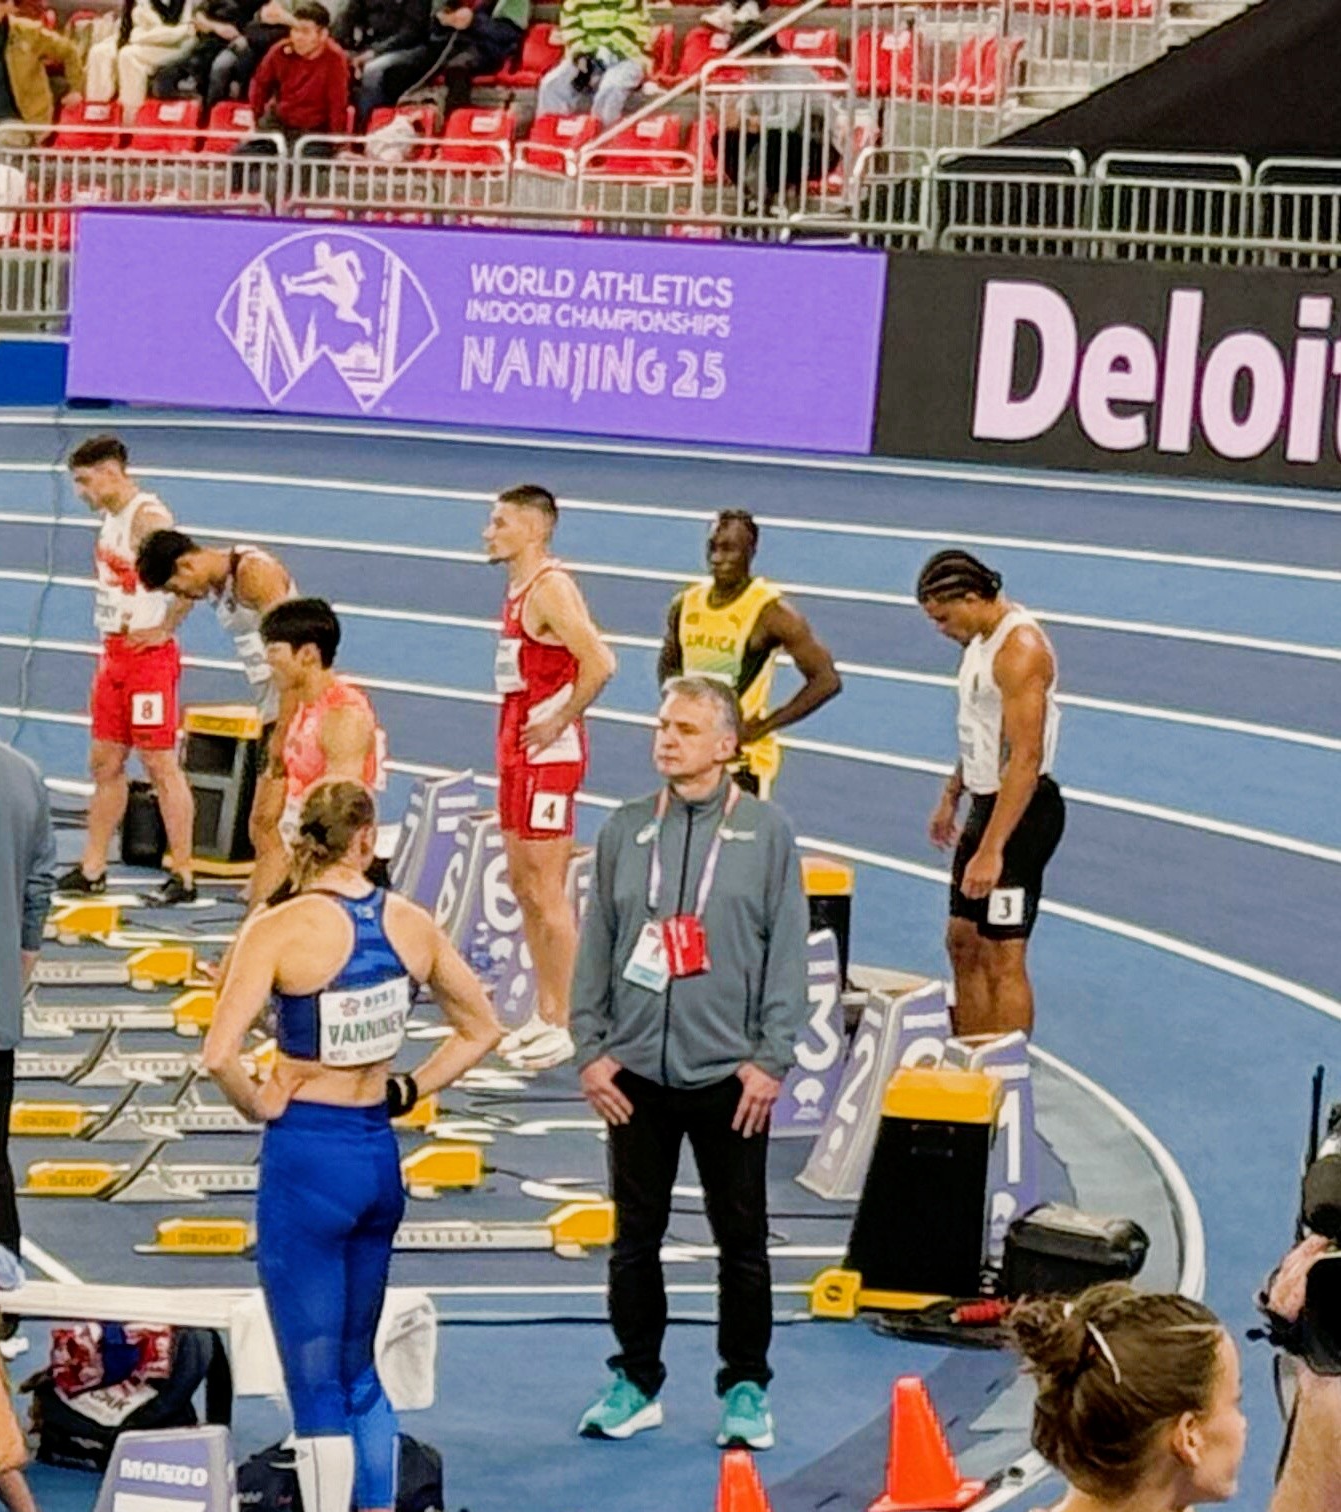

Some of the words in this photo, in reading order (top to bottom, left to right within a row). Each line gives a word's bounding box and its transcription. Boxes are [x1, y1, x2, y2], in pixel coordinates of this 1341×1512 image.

[470, 263, 576, 298] WORLD
[579, 269, 734, 308] ATHLETICS
[465, 299, 552, 326] INDOOR
[555, 303, 731, 338] CHAMPIONSHIPS
[460, 336, 667, 403] NANJING
[671, 349, 727, 400] 25
[972, 279, 1341, 463] Deloi
[141, 699, 153, 720] 8
[542, 802, 557, 822] 4
[997, 896, 1012, 919] 3
[793, 983, 841, 1072] 3
[997, 1090, 1022, 1184] 1
[119, 1457, 209, 1488] MONDO
